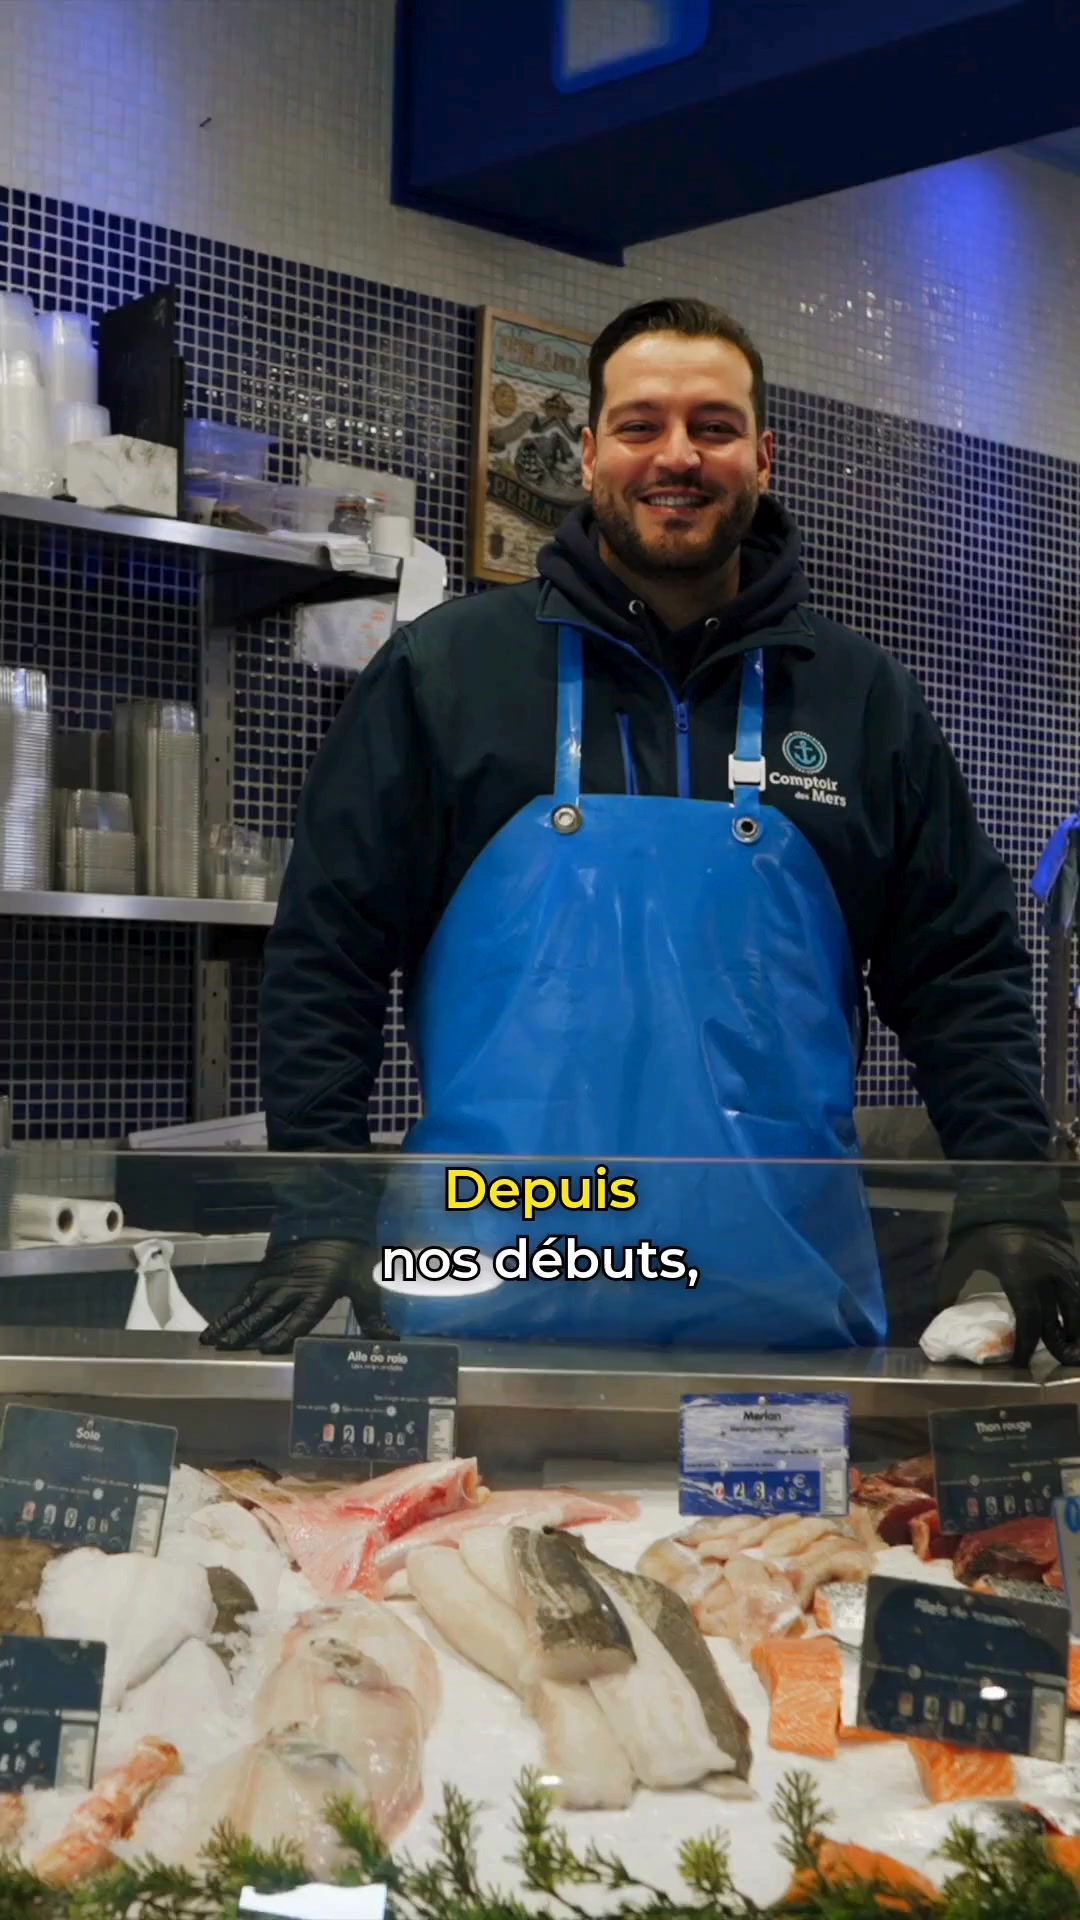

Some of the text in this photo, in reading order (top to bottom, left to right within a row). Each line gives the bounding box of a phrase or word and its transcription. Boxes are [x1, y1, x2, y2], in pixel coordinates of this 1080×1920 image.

[769, 771, 838, 791] Comptoir
[812, 789, 847, 807] Mers
[743, 1411, 782, 1421] Merlan
[76, 1427, 101, 1441] Sole
